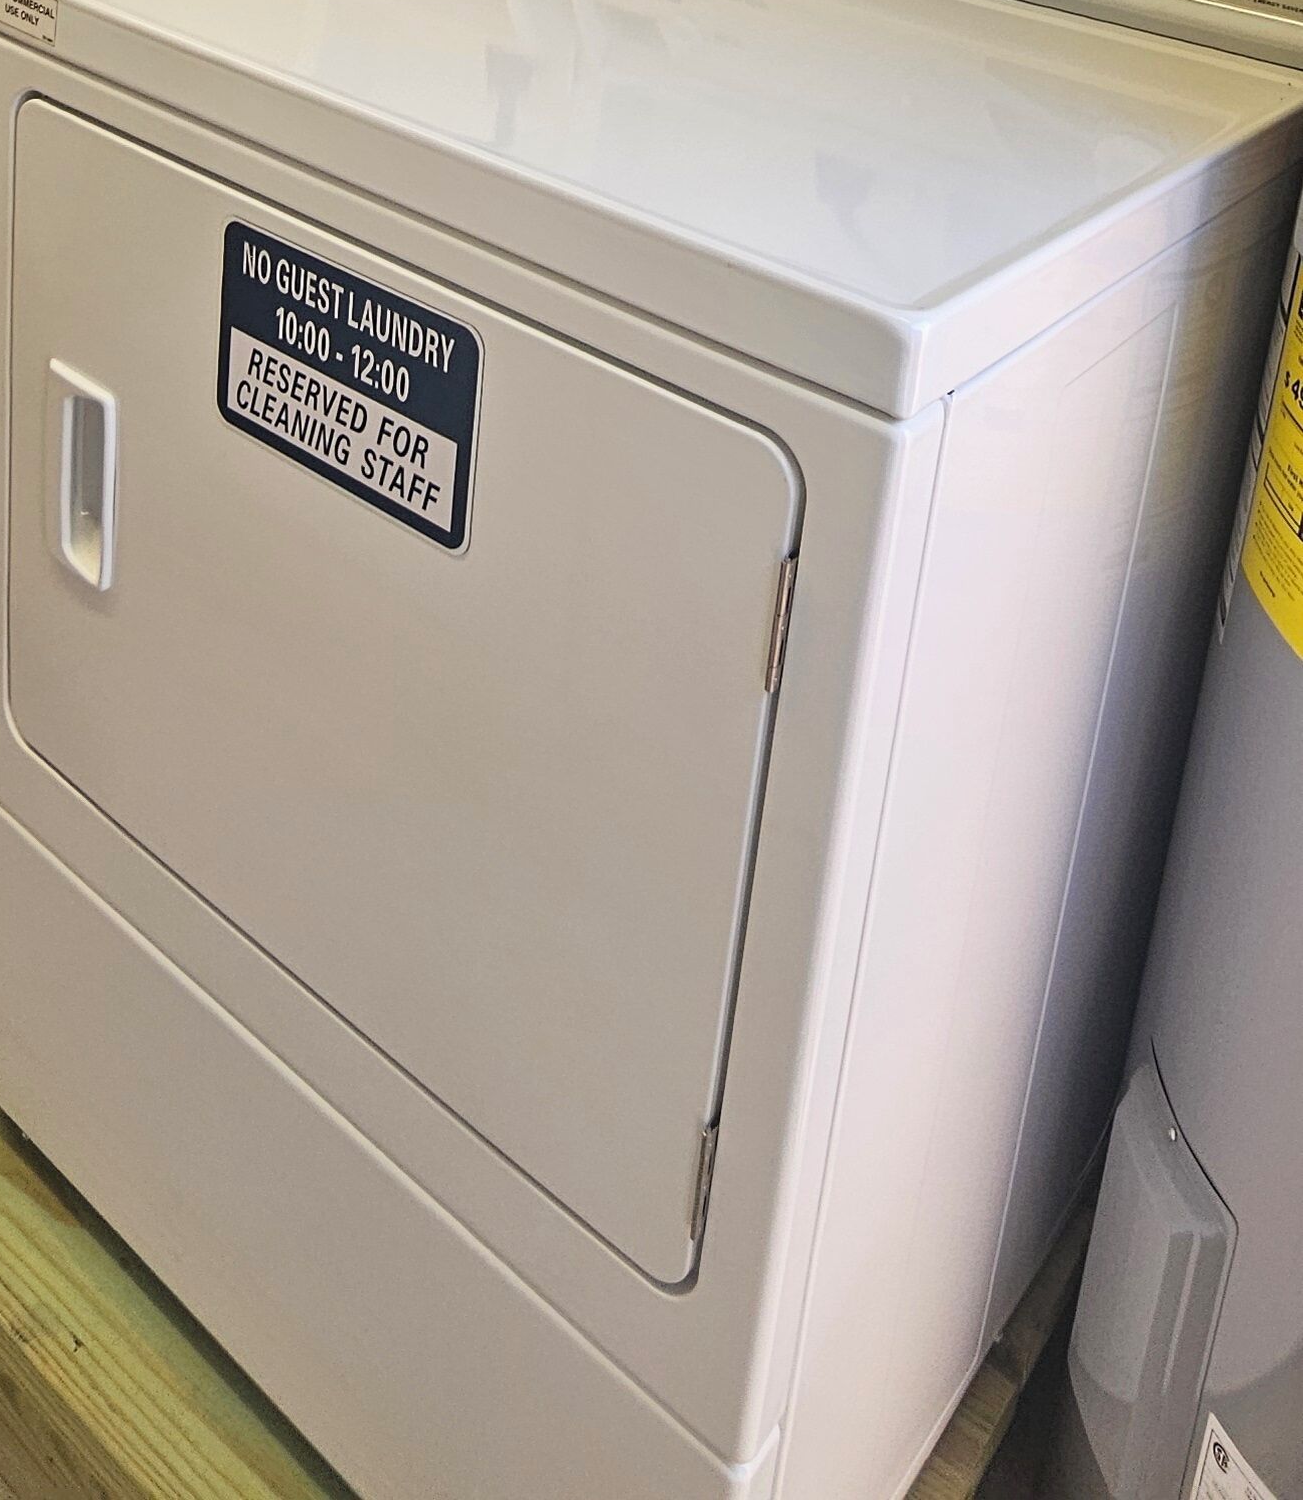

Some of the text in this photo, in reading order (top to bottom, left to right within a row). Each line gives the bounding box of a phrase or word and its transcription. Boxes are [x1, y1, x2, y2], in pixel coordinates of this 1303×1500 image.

[5, 3, 40, 26] USE ONLY
[243, 241, 455, 374] NO GUEST LAUNDRY
[276, 306, 331, 362] 10:00
[351, 344, 410, 403] 12:00
[236, 379, 441, 512] CLEANING STAFF
[247, 348, 430, 469] RESERVED FOR
